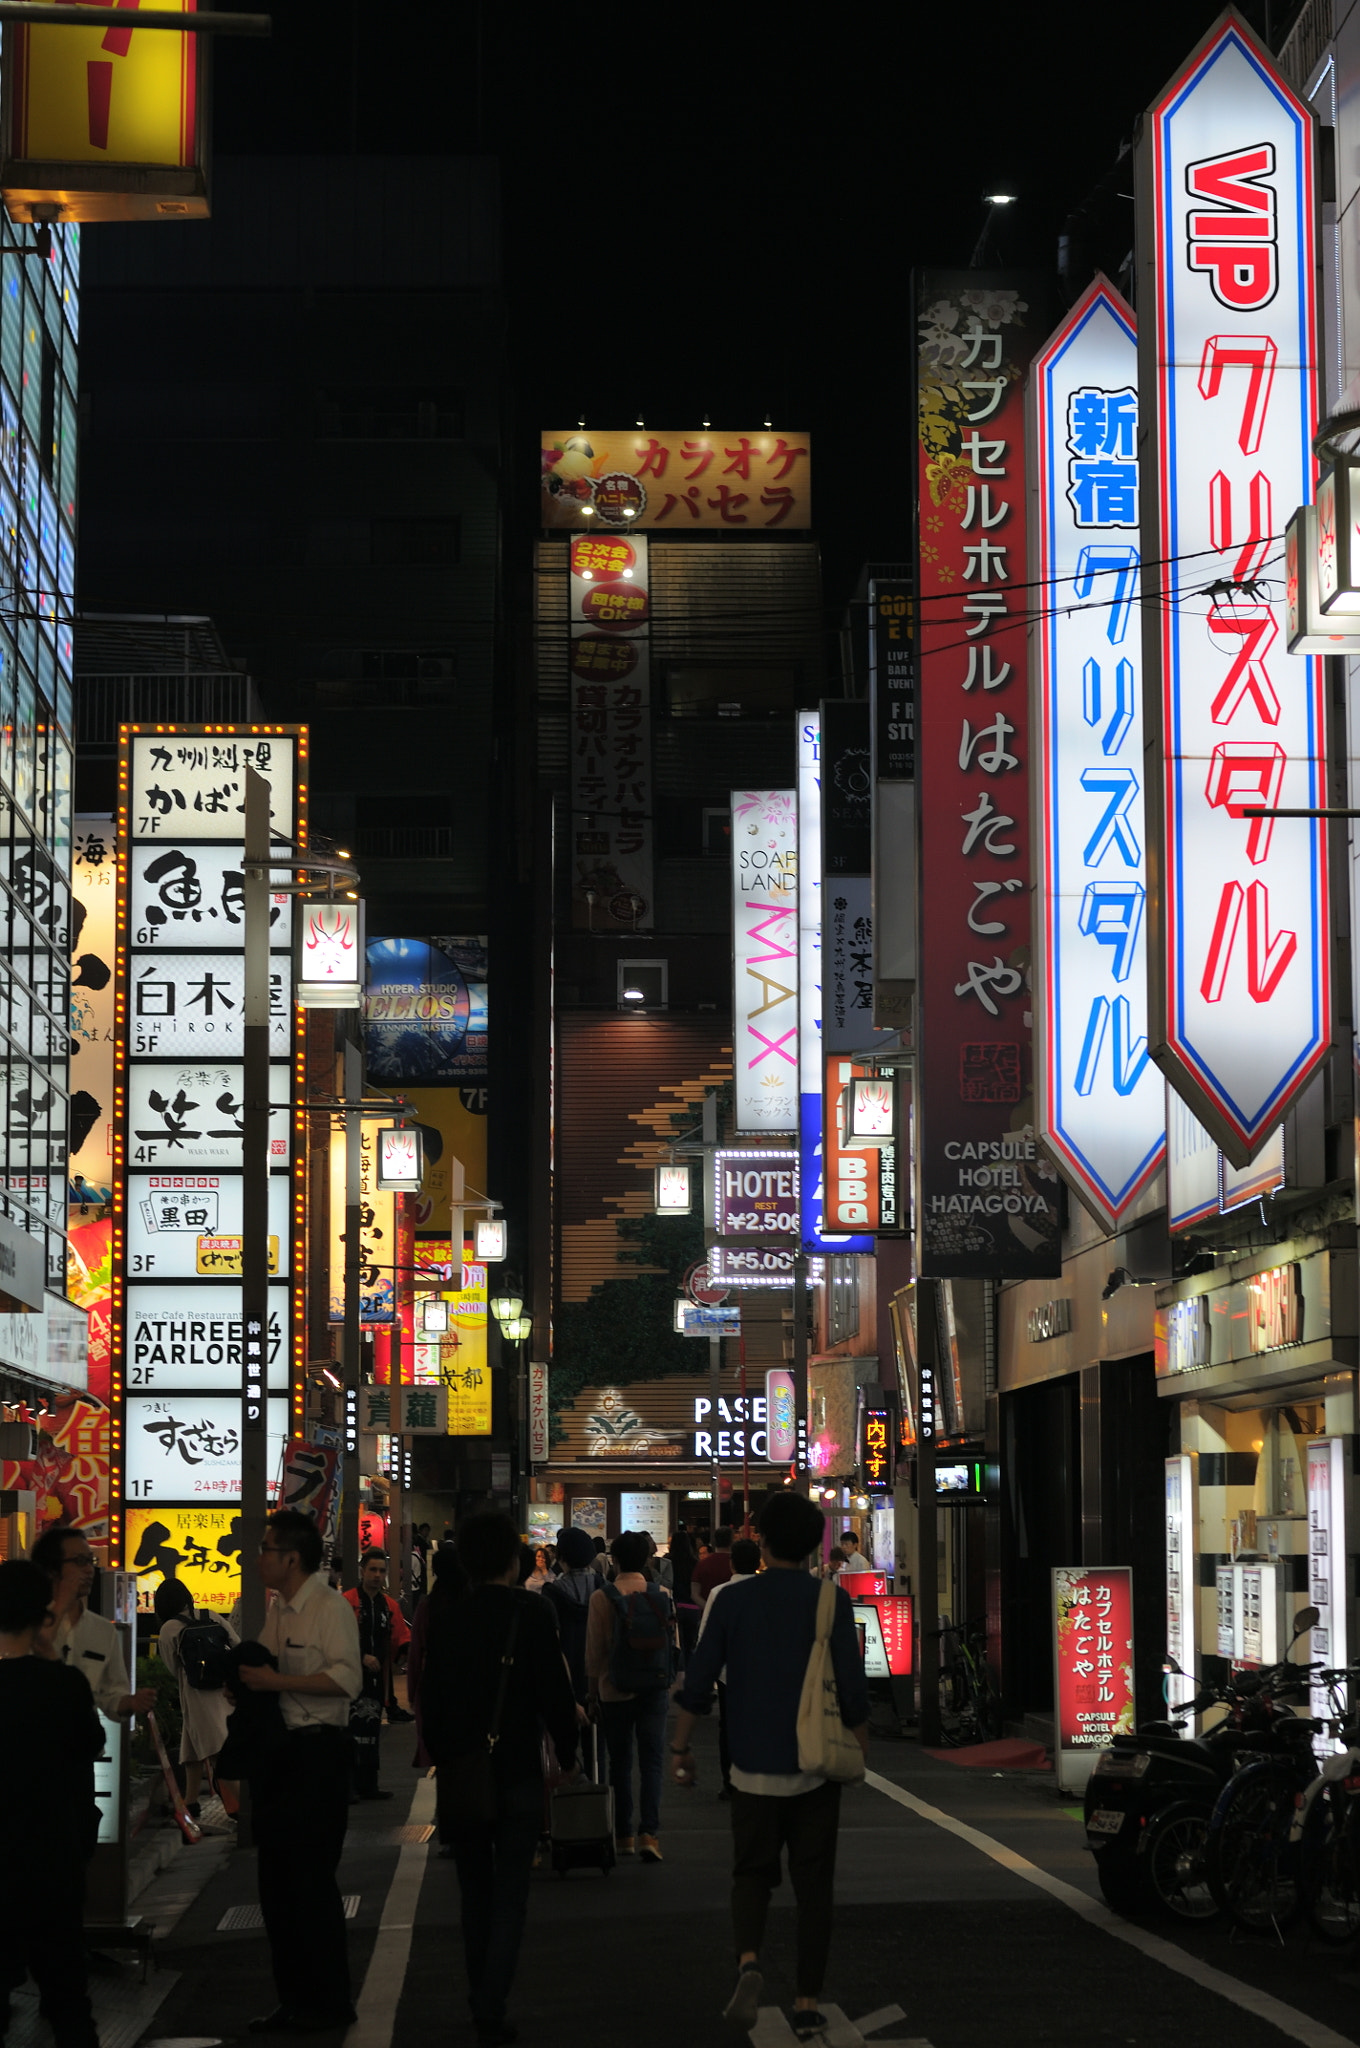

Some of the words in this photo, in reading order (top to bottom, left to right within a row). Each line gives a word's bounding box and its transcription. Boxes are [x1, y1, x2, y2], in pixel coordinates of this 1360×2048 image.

[1185, 142, 1279, 312] VIP
[634, 438, 807, 480] カラオケ
[1066, 387, 1140, 529] 新宿
[654, 484, 796, 526] パセラ
[960, 325, 1010, 690] カプセルホテル
[576, 542, 629, 560] 2次会
[574, 555, 626, 573] 3次会
[1197, 335, 1297, 1003] クリスタル
[146, 783, 275, 815] かば
[138, 817, 161, 834] 7F
[1074, 545, 1148, 1097] クリスタル
[954, 712, 1023, 1015] はたごや
[136, 927, 160, 944] 6F
[381, 984, 414, 994] HYPER
[419, 984, 458, 994] STUDIO
[136, 1036, 158, 1053] 5F
[134, 1145, 157, 1163] 4F
[944, 1142, 1036, 1160] CAPSULE
[958, 1169, 1022, 1187] HOTEL
[838, 1158, 868, 1225] BBQ
[754, 1202, 778, 1210] REST
[932, 1196, 1049, 1214] HATAGOYA
[160, 1207, 208, 1228] 黒田
[132, 1255, 155, 1272] 3F
[362, 1296, 382, 1313] 2F
[135, 1312, 157, 1320] Beer
[162, 1312, 184, 1320] Cafe
[132, 1368, 155, 1384] 2F
[247, 1320, 261, 1420] 仲見世通り
[532, 1368, 544, 1455] カラオケパセラ
[131, 1480, 154, 1496] 1F
[177, 1514, 225, 1529] 居楽屋
[361, 1520, 371, 1551] ラーメン
[1072, 1586, 1094, 1678] はたごや
[1095, 1586, 1115, 1703] カプセルホテル
[1076, 1712, 1116, 1722] CAPSULE
[1082, 1723, 1110, 1732] HOTEL
